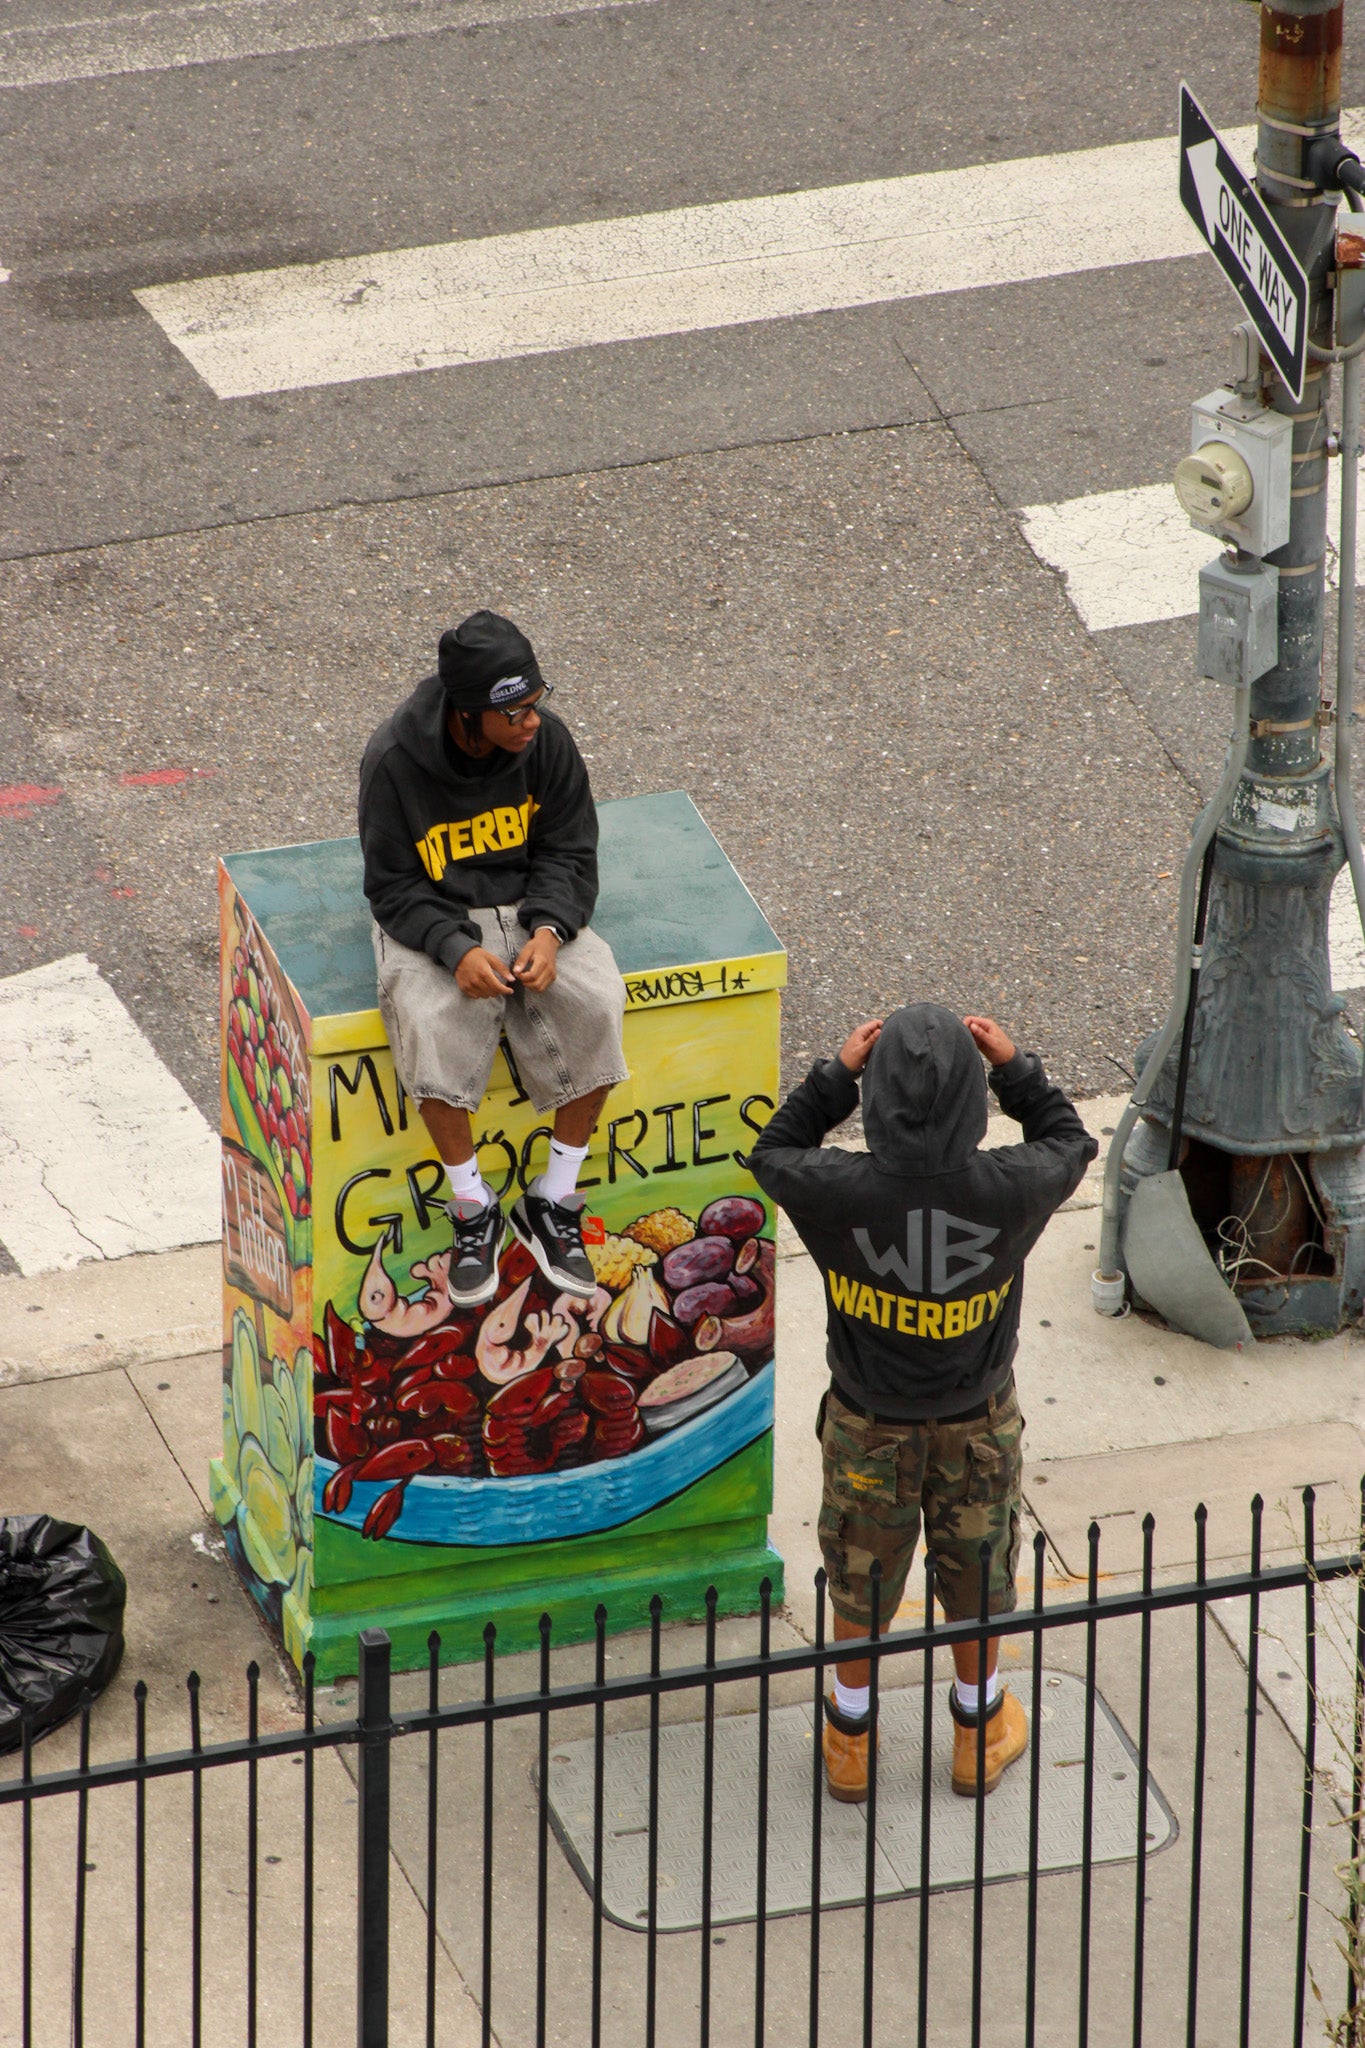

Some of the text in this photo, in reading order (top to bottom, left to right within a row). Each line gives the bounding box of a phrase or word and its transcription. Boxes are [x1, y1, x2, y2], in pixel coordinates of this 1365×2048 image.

[1219, 184, 1293, 333] ONE WAY
[851, 1208, 1001, 1295] WB
